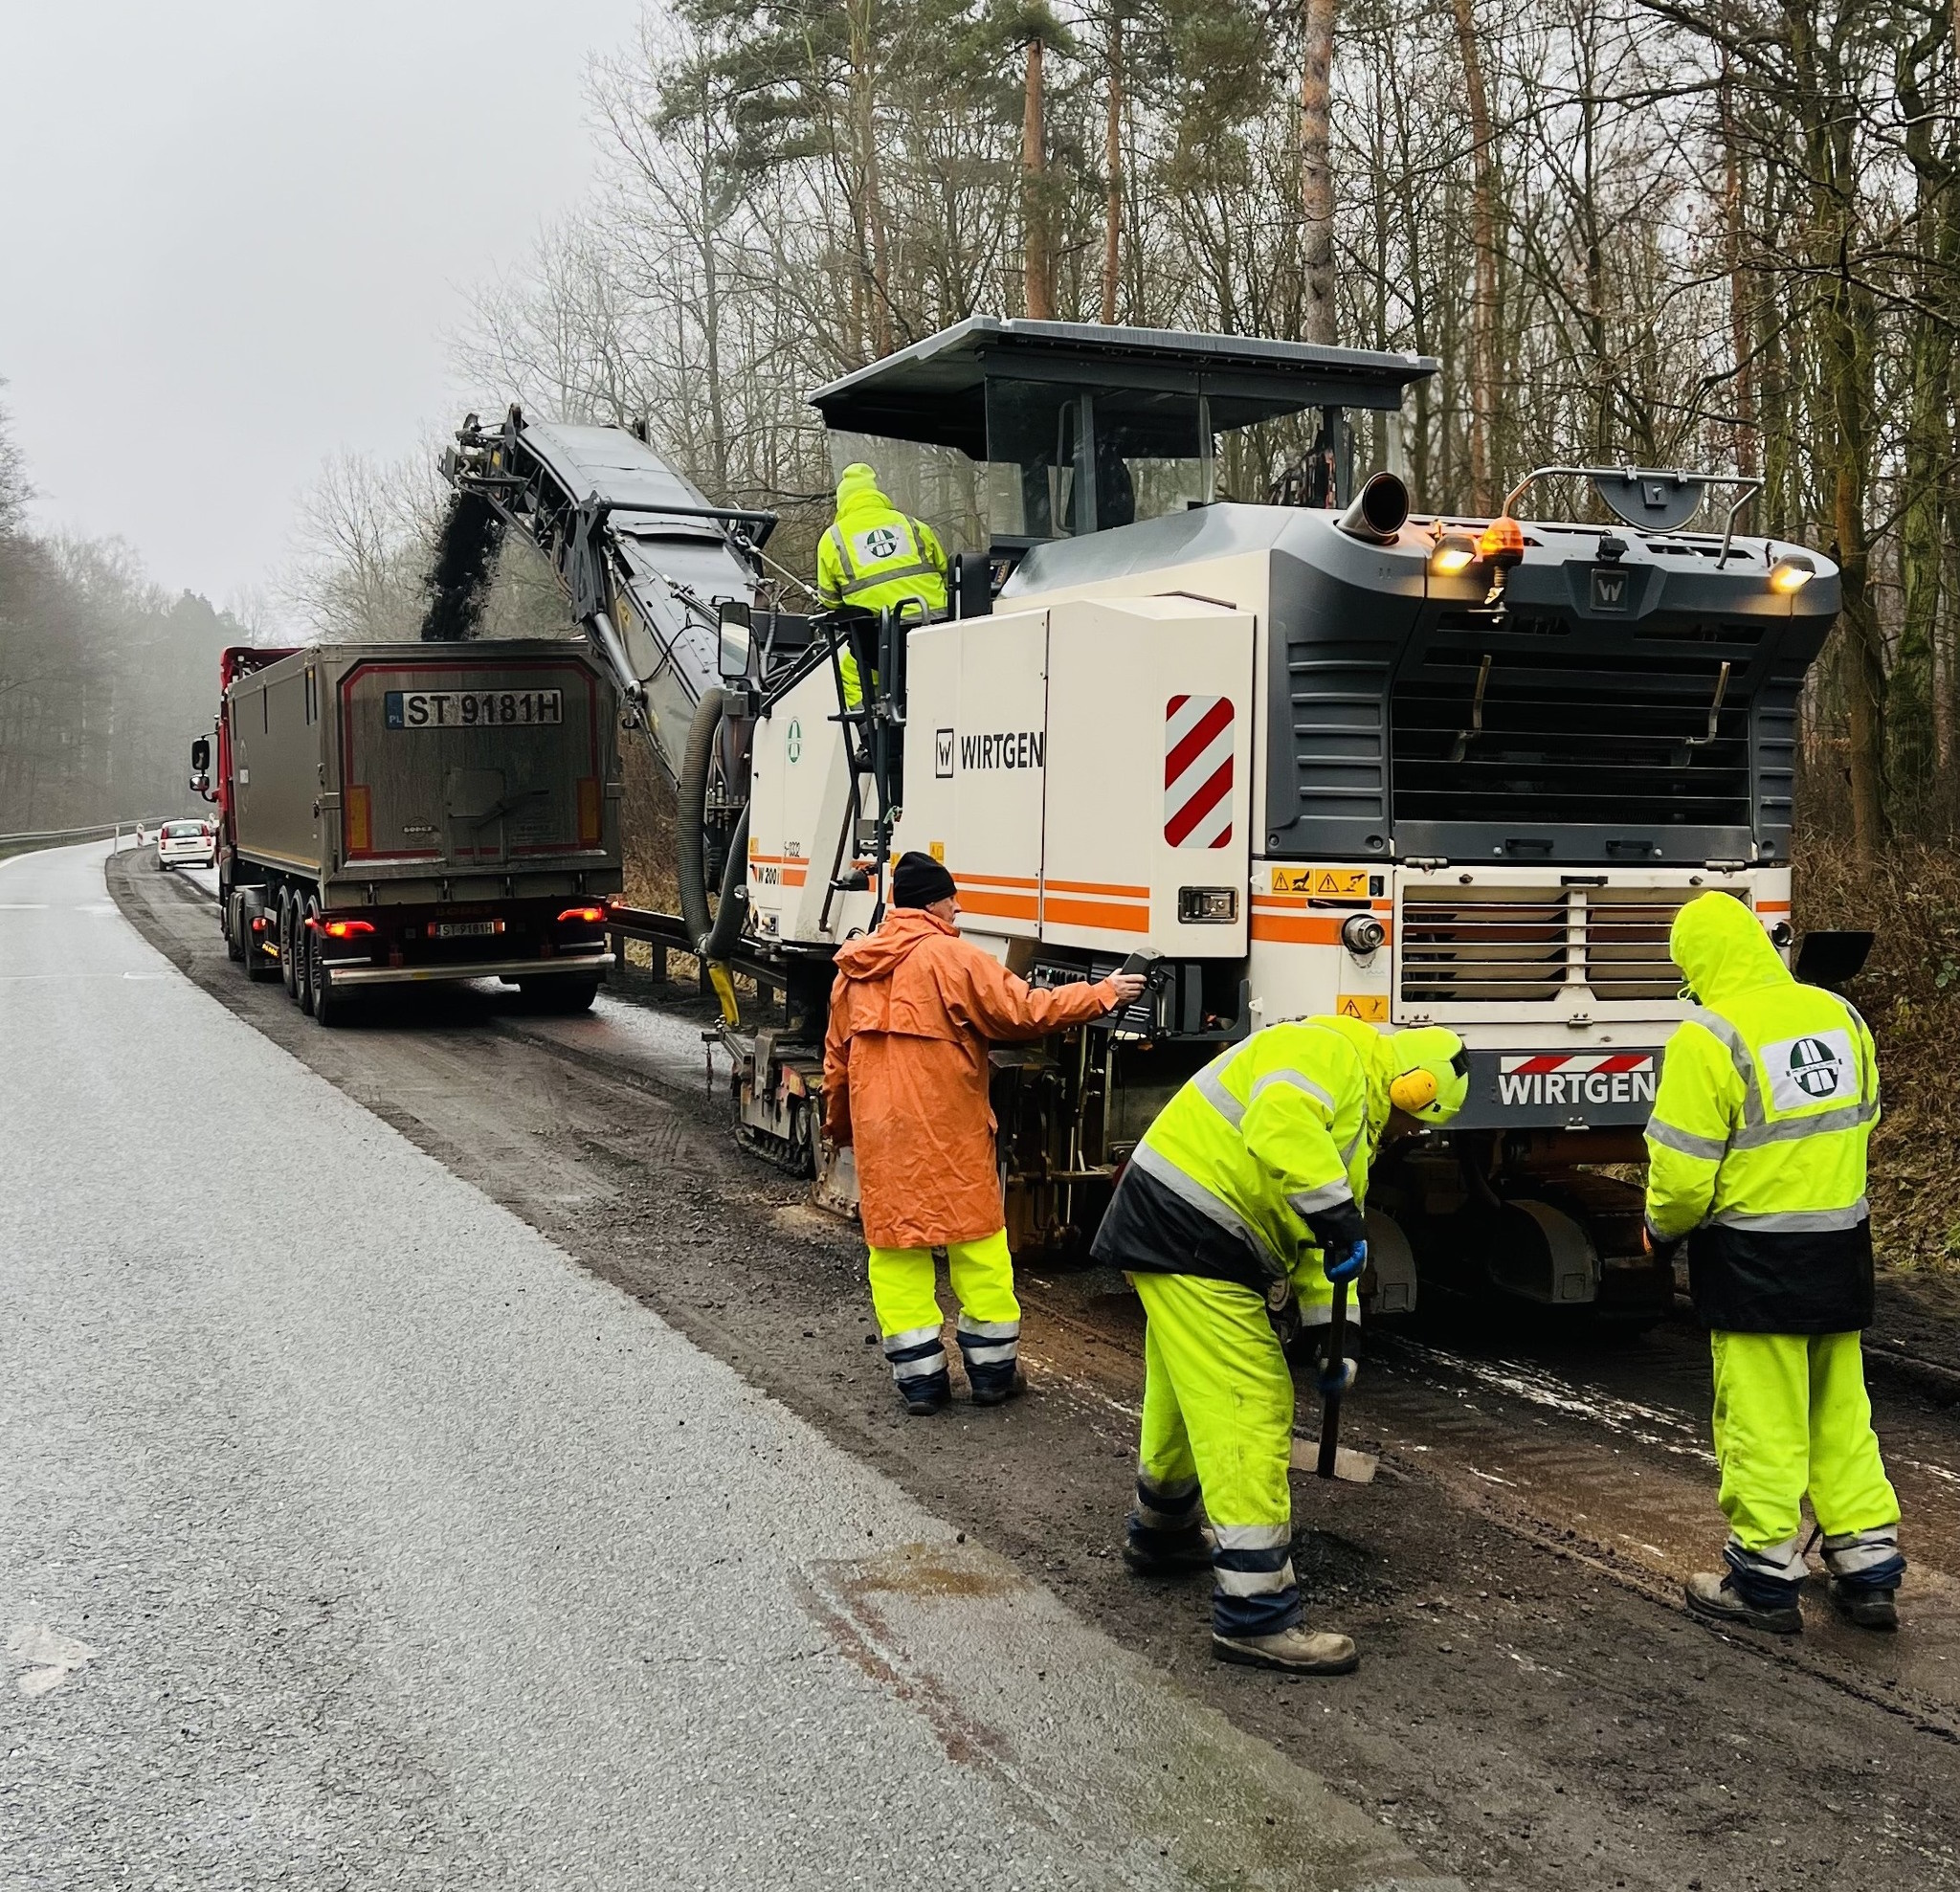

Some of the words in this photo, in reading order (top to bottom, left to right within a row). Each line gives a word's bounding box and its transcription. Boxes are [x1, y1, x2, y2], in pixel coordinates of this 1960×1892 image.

[389, 715, 402, 723] PL
[408, 695, 451, 724] ST
[460, 693, 559, 723] 9181H
[961, 731, 1043, 769] WIRTGEN
[758, 866, 765, 883] W
[442, 924, 456, 936] ST
[1498, 1072, 1656, 1105] WIRTGEN
